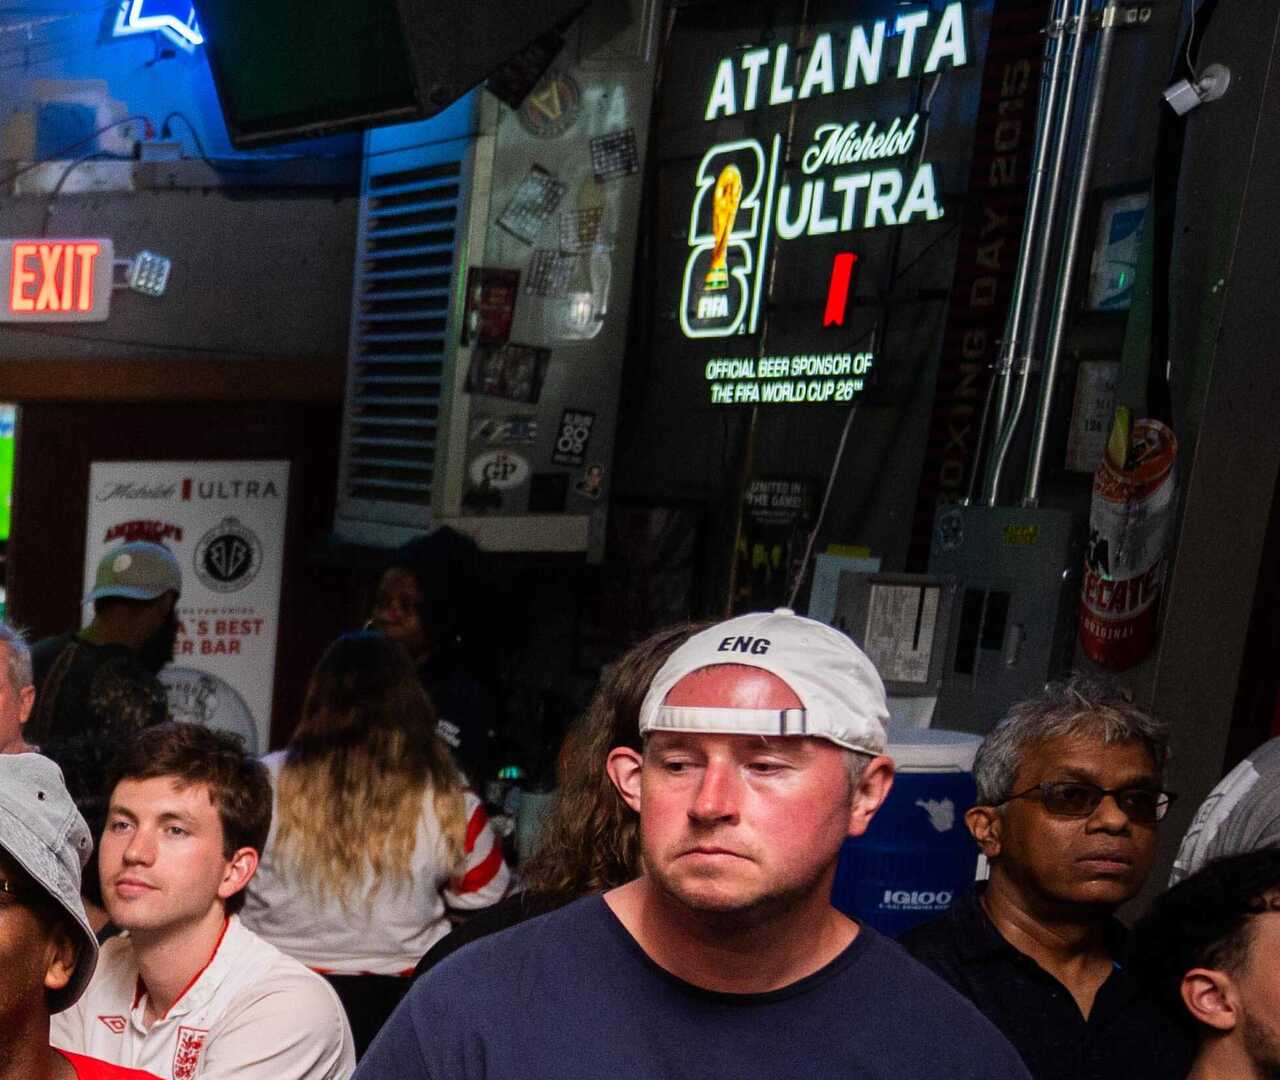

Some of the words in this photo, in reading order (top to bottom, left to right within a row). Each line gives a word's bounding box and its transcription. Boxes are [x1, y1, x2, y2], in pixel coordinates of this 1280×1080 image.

[704, 2, 967, 121] ATLANTA
[802, 113, 919, 175] Michelob
[775, 163, 940, 240] ULTRA
[10, 243, 100, 313] EXIT
[697, 295, 729, 319] FIFA
[705, 357, 755, 380] OFFICIAL
[758, 358, 790, 378] BEER
[791, 354, 850, 377] SPONSOR
[853, 352, 873, 374] OF
[711, 383, 733, 404] THE
[735, 381, 760, 402] FIFA
[761, 379, 806, 402] WORLD
[807, 379, 834, 401] CUP
[197, 480, 280, 499] ULTRA
[216, 620, 264, 636] BEST
[201, 640, 241, 655] BAR
[717, 636, 771, 655] ENG
[883, 890, 952, 905] IGLOO
